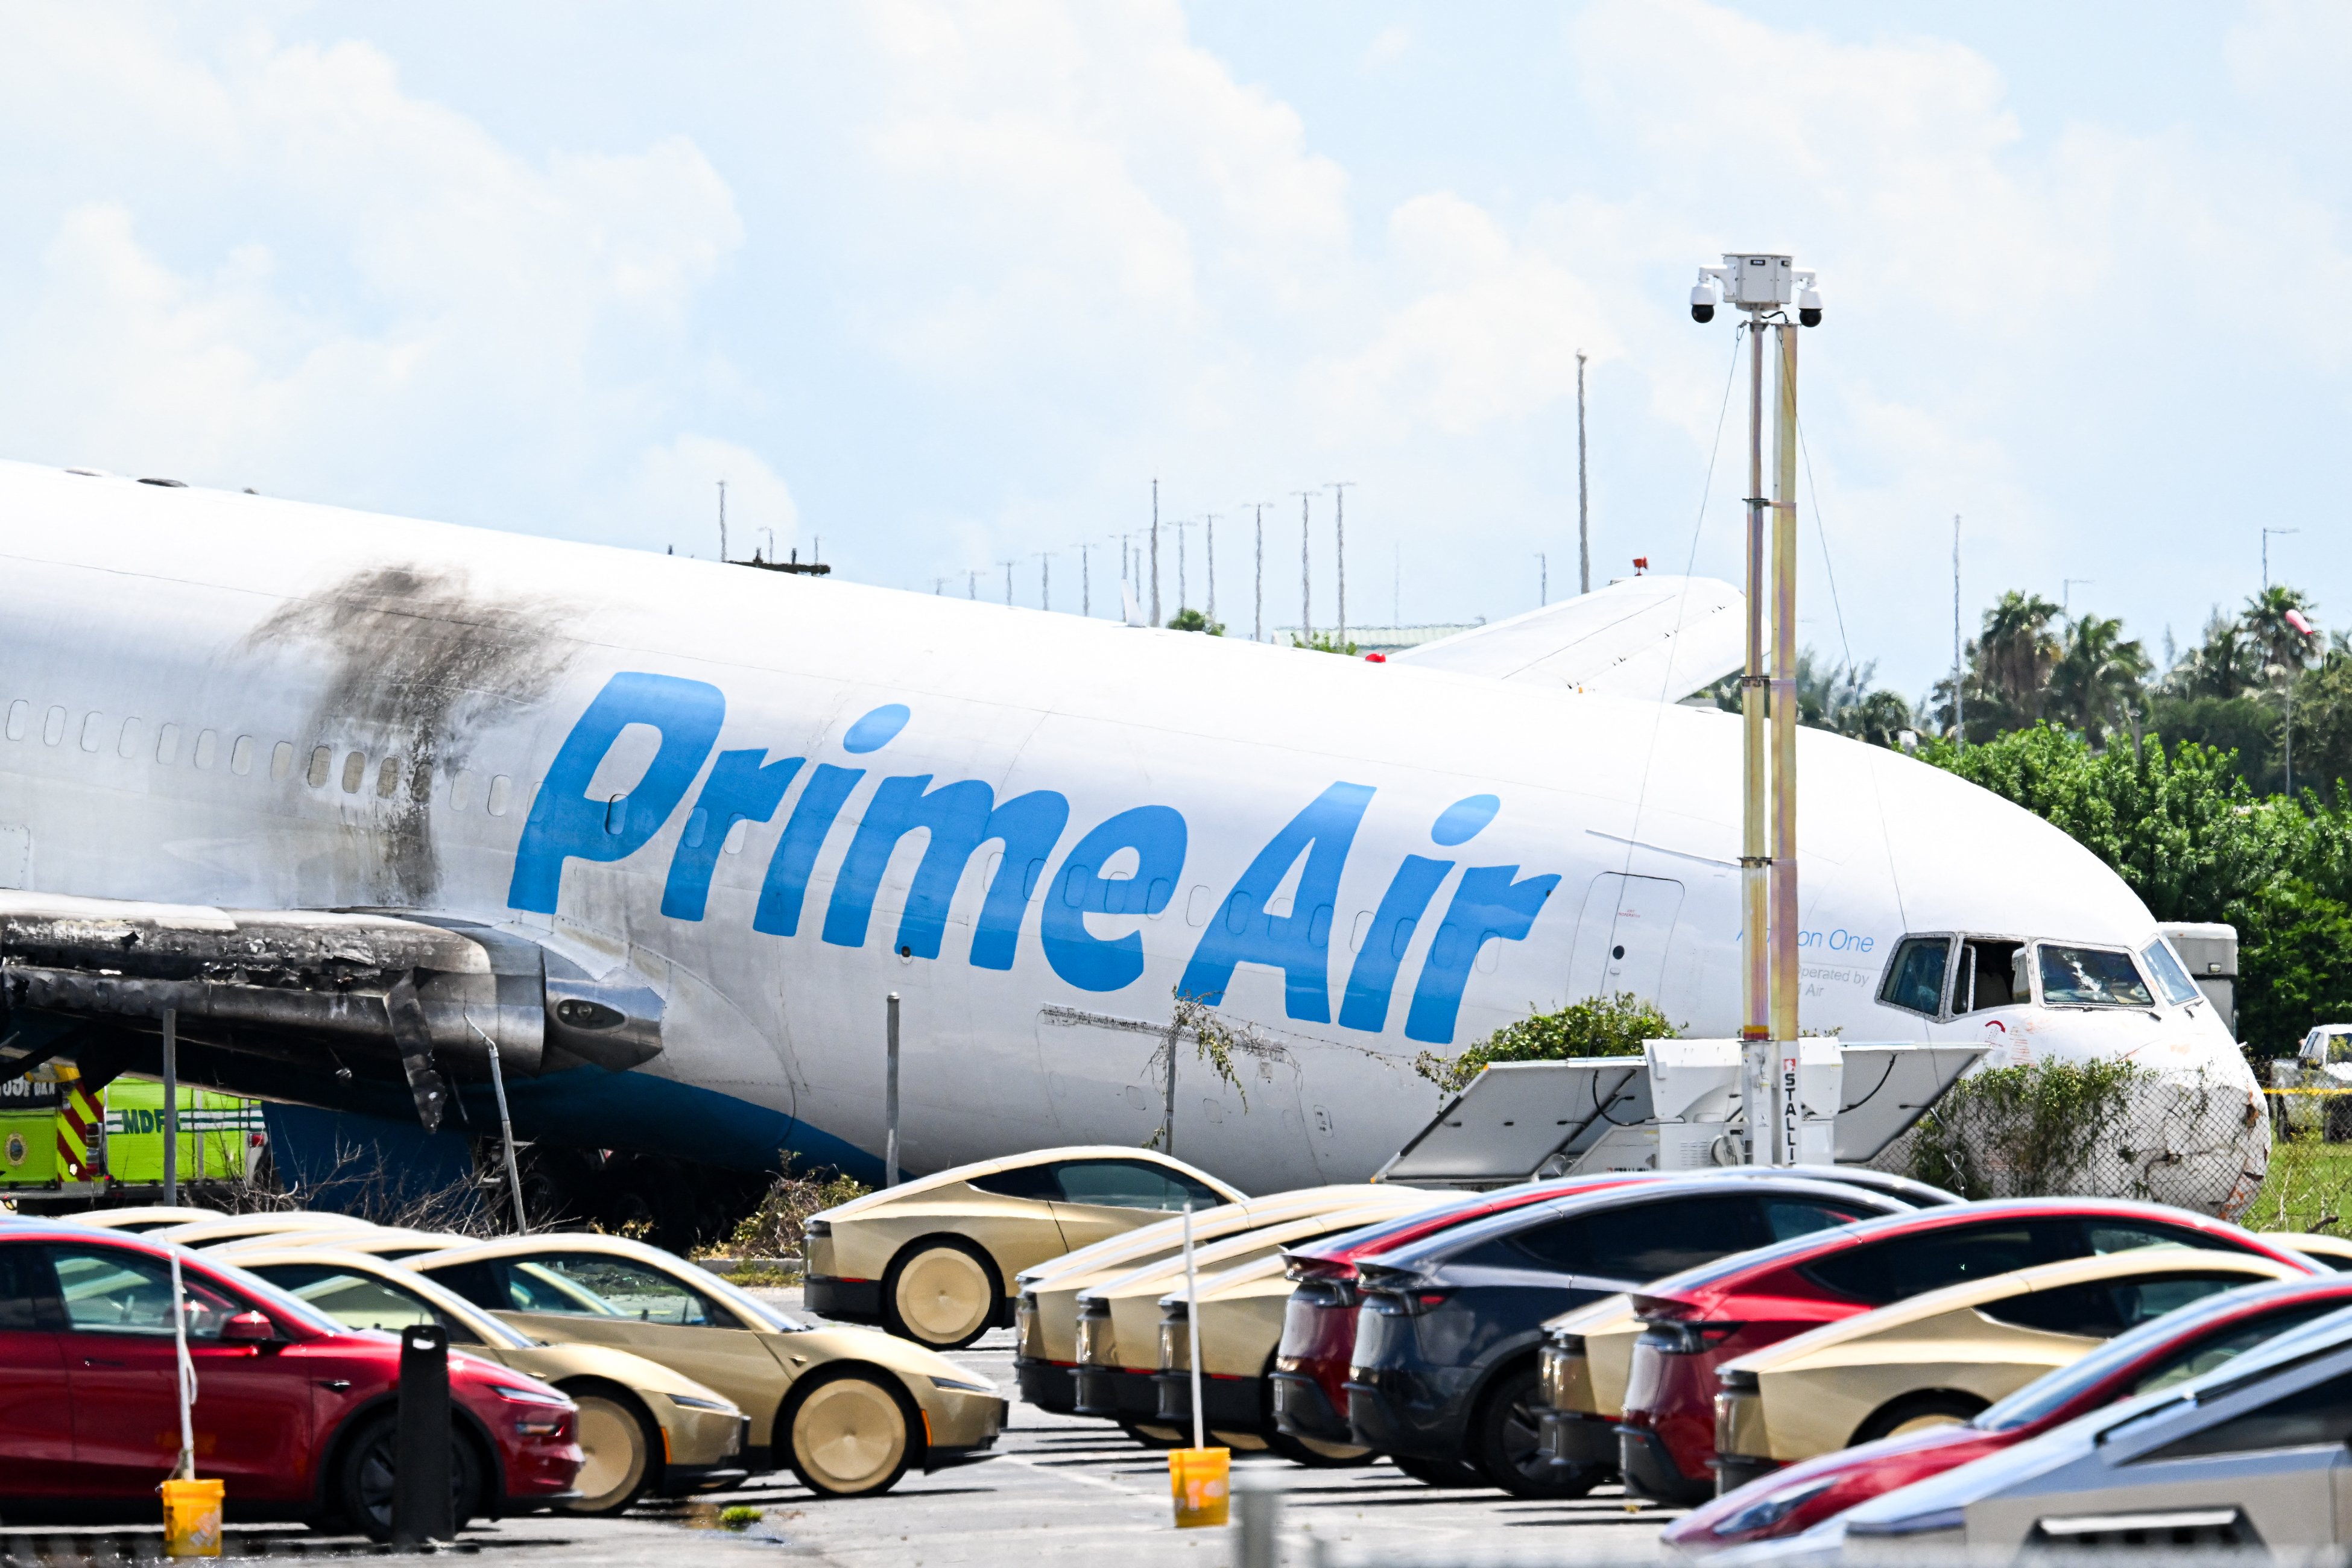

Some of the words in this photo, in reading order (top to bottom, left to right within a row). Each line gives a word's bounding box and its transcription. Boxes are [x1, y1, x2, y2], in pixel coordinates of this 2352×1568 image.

[507, 672, 1188, 993] Prime
[1177, 782, 1561, 1043] Air
[1830, 929, 1874, 952] One
[1798, 965, 1850, 981] perated
[1853, 971, 1870, 987] by
[1805, 984, 1824, 996] Air
[1785, 1073, 1797, 1165] STALLI
